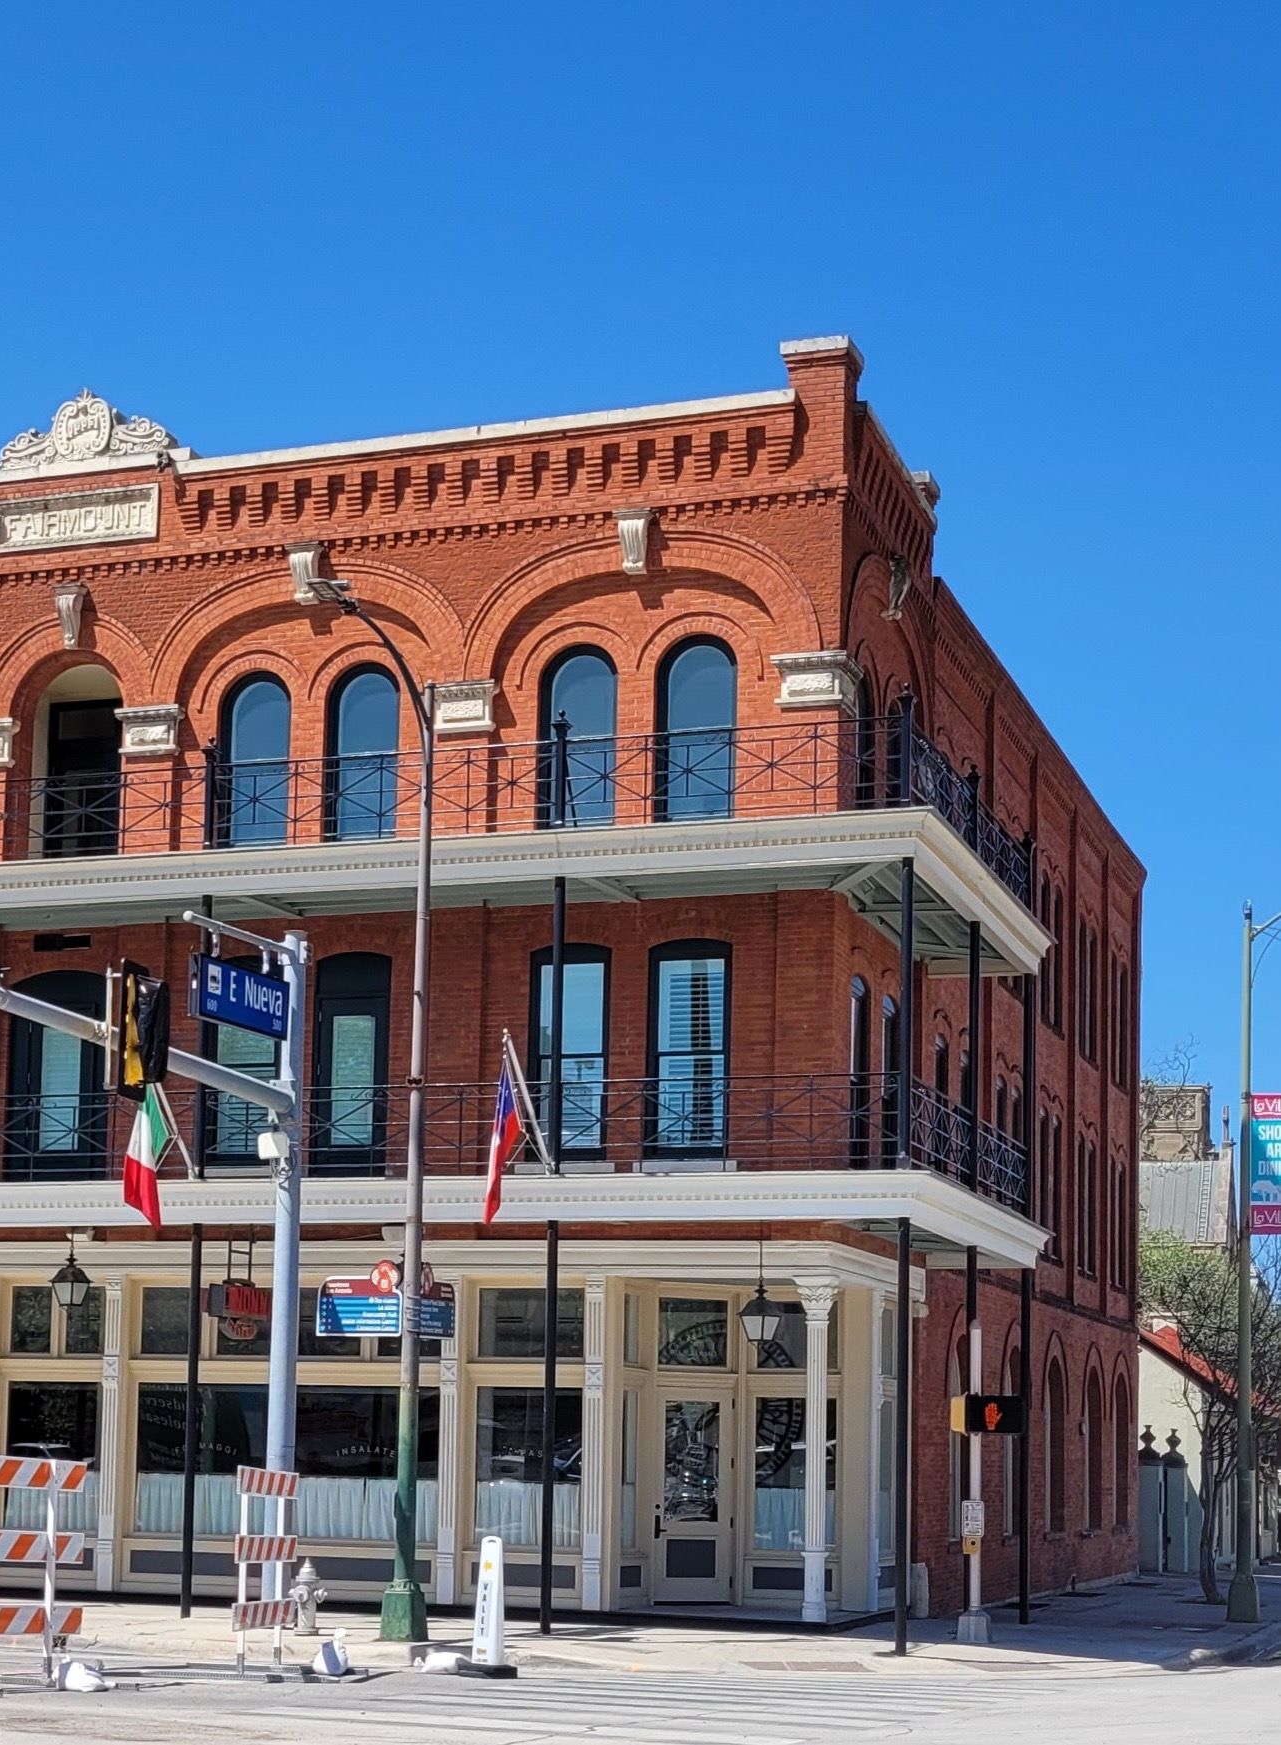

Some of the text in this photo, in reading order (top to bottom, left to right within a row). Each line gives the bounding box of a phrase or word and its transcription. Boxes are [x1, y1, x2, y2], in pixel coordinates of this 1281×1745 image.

[5, 501, 147, 539] FAIRMOUNT
[206, 997, 218, 1012] 600
[229, 971, 283, 1017] E Nueva
[272, 1017, 282, 1031] 500
[479, 1583, 489, 1636] VALET
